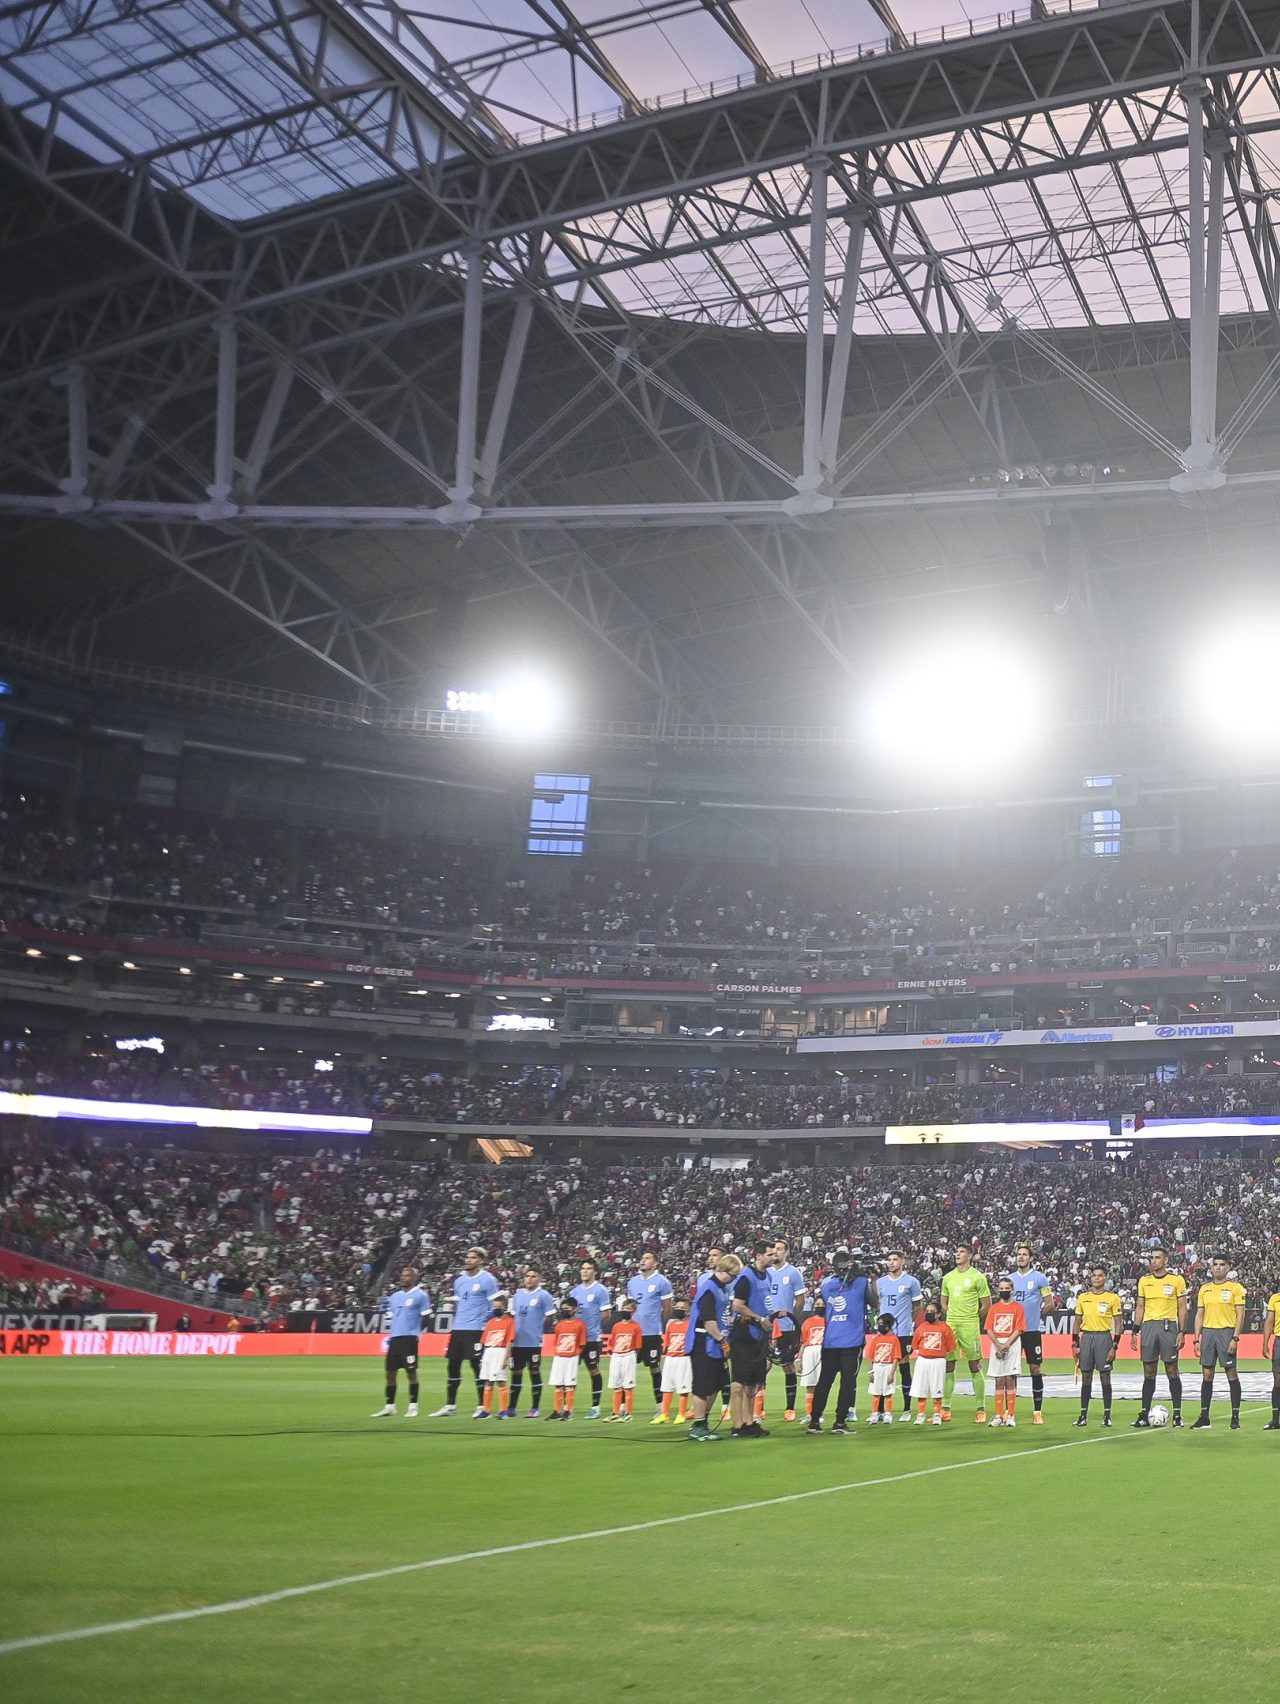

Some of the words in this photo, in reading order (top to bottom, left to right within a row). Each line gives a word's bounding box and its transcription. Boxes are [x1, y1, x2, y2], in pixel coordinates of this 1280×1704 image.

[345, 964, 372, 973] ROY
[373, 966, 414, 977] GREEN
[716, 984, 759, 992] CARSON
[762, 985, 802, 993] PALMER
[897, 980, 926, 988] ERNIE
[928, 978, 967, 987] NEVERS
[1178, 1025, 1234, 1036] HYUNDAI
[887, 1294, 897, 1306] 15
[1016, 1290, 1025, 1302] 21
[12, 1334, 50, 1354] APP
[61, 1332, 109, 1355] THE
[111, 1332, 172, 1355] HOME
[174, 1333, 243, 1355] DEPOT
